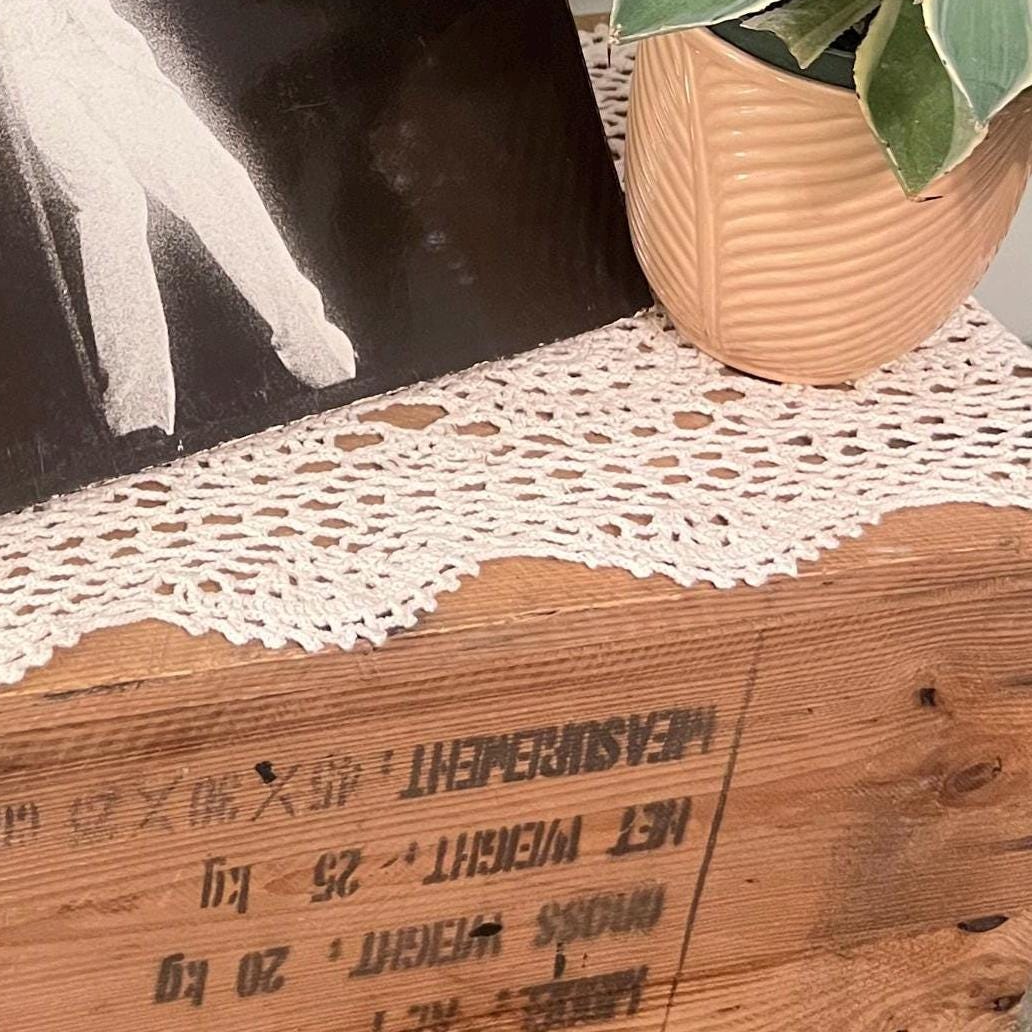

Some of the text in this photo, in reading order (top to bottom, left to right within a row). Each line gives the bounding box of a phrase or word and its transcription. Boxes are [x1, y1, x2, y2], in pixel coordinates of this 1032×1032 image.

[605, 796, 693, 858] NET
[200, 856, 251, 914] kg
[309, 848, 363, 903] 25
[152, 953, 209, 1007] kg
[235, 945, 291, 999] 20
